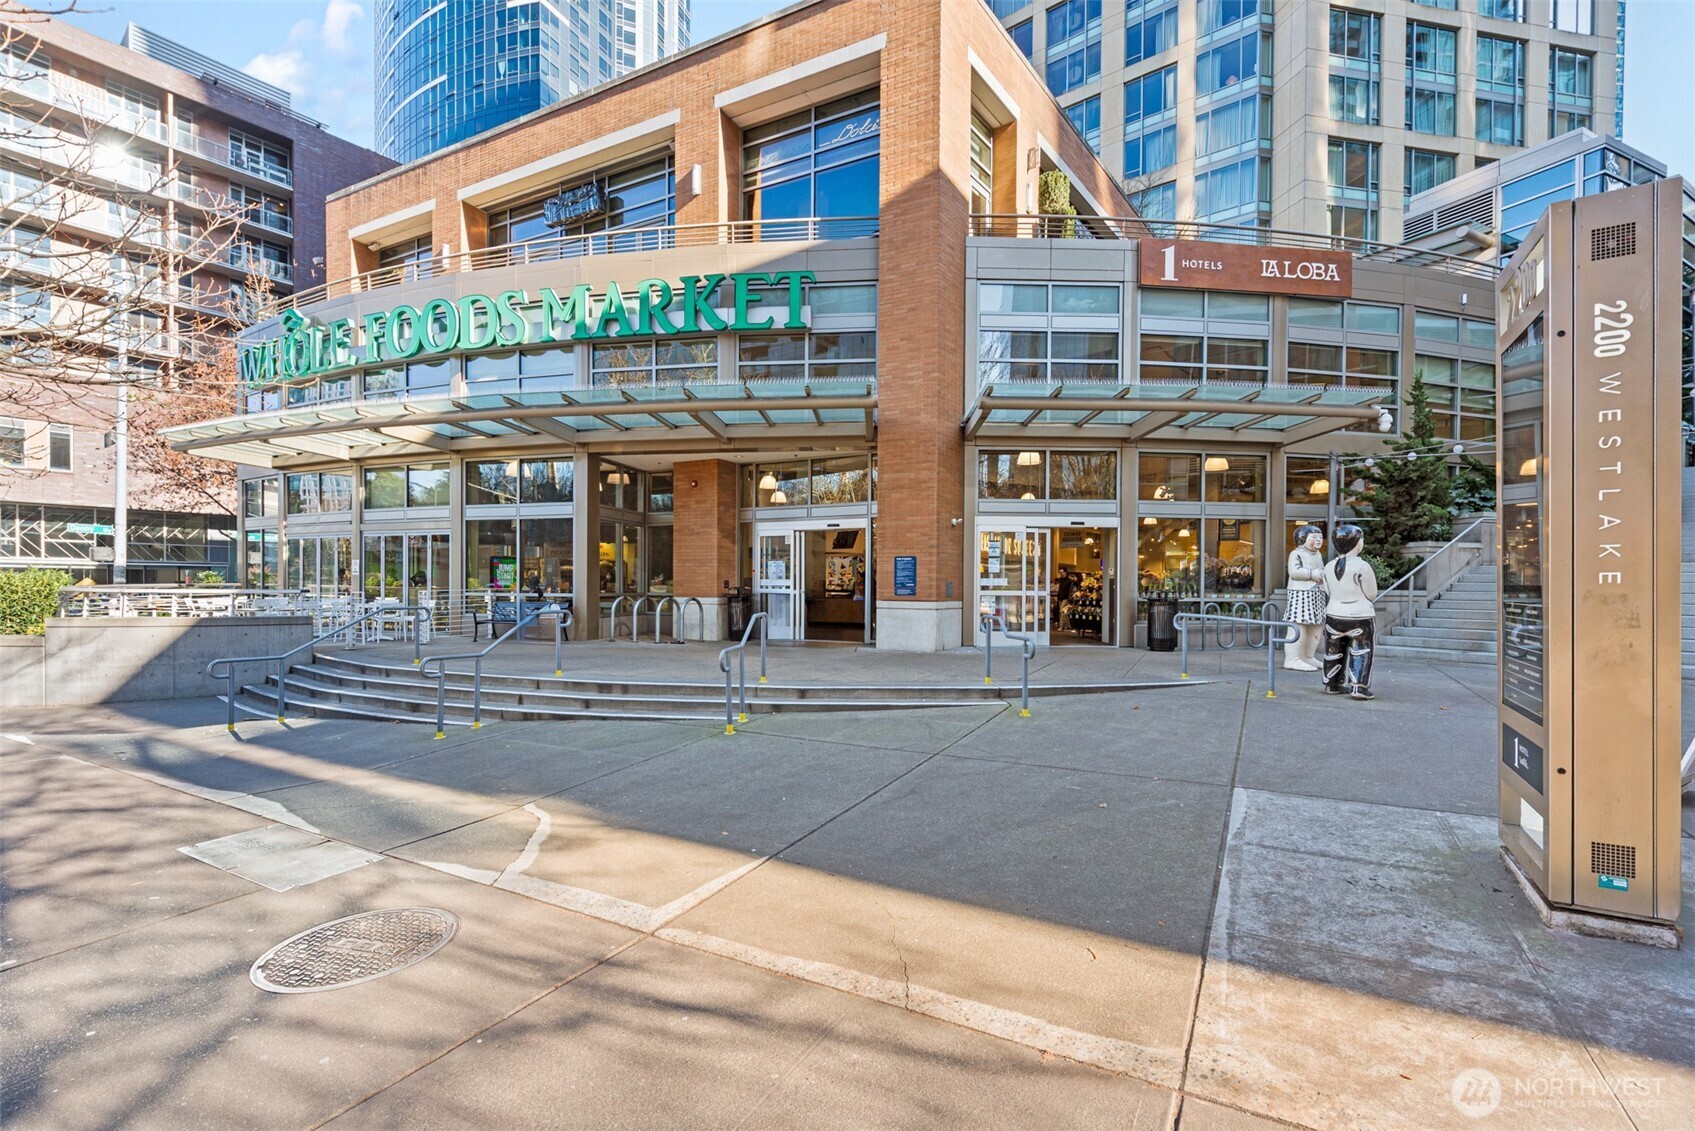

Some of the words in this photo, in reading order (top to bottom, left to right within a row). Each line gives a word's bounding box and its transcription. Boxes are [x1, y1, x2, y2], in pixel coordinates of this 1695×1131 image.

[1161, 244, 1178, 281] 1
[1182, 259, 1223, 270] HOTELS
[1284, 261, 1341, 281] LOBA
[240, 309, 359, 388] WHOLE
[363, 289, 530, 364] FOODS
[538, 270, 817, 343] MARKET
[1593, 300, 1634, 358] 2200
[1598, 371, 1622, 585] WESTLAKE
